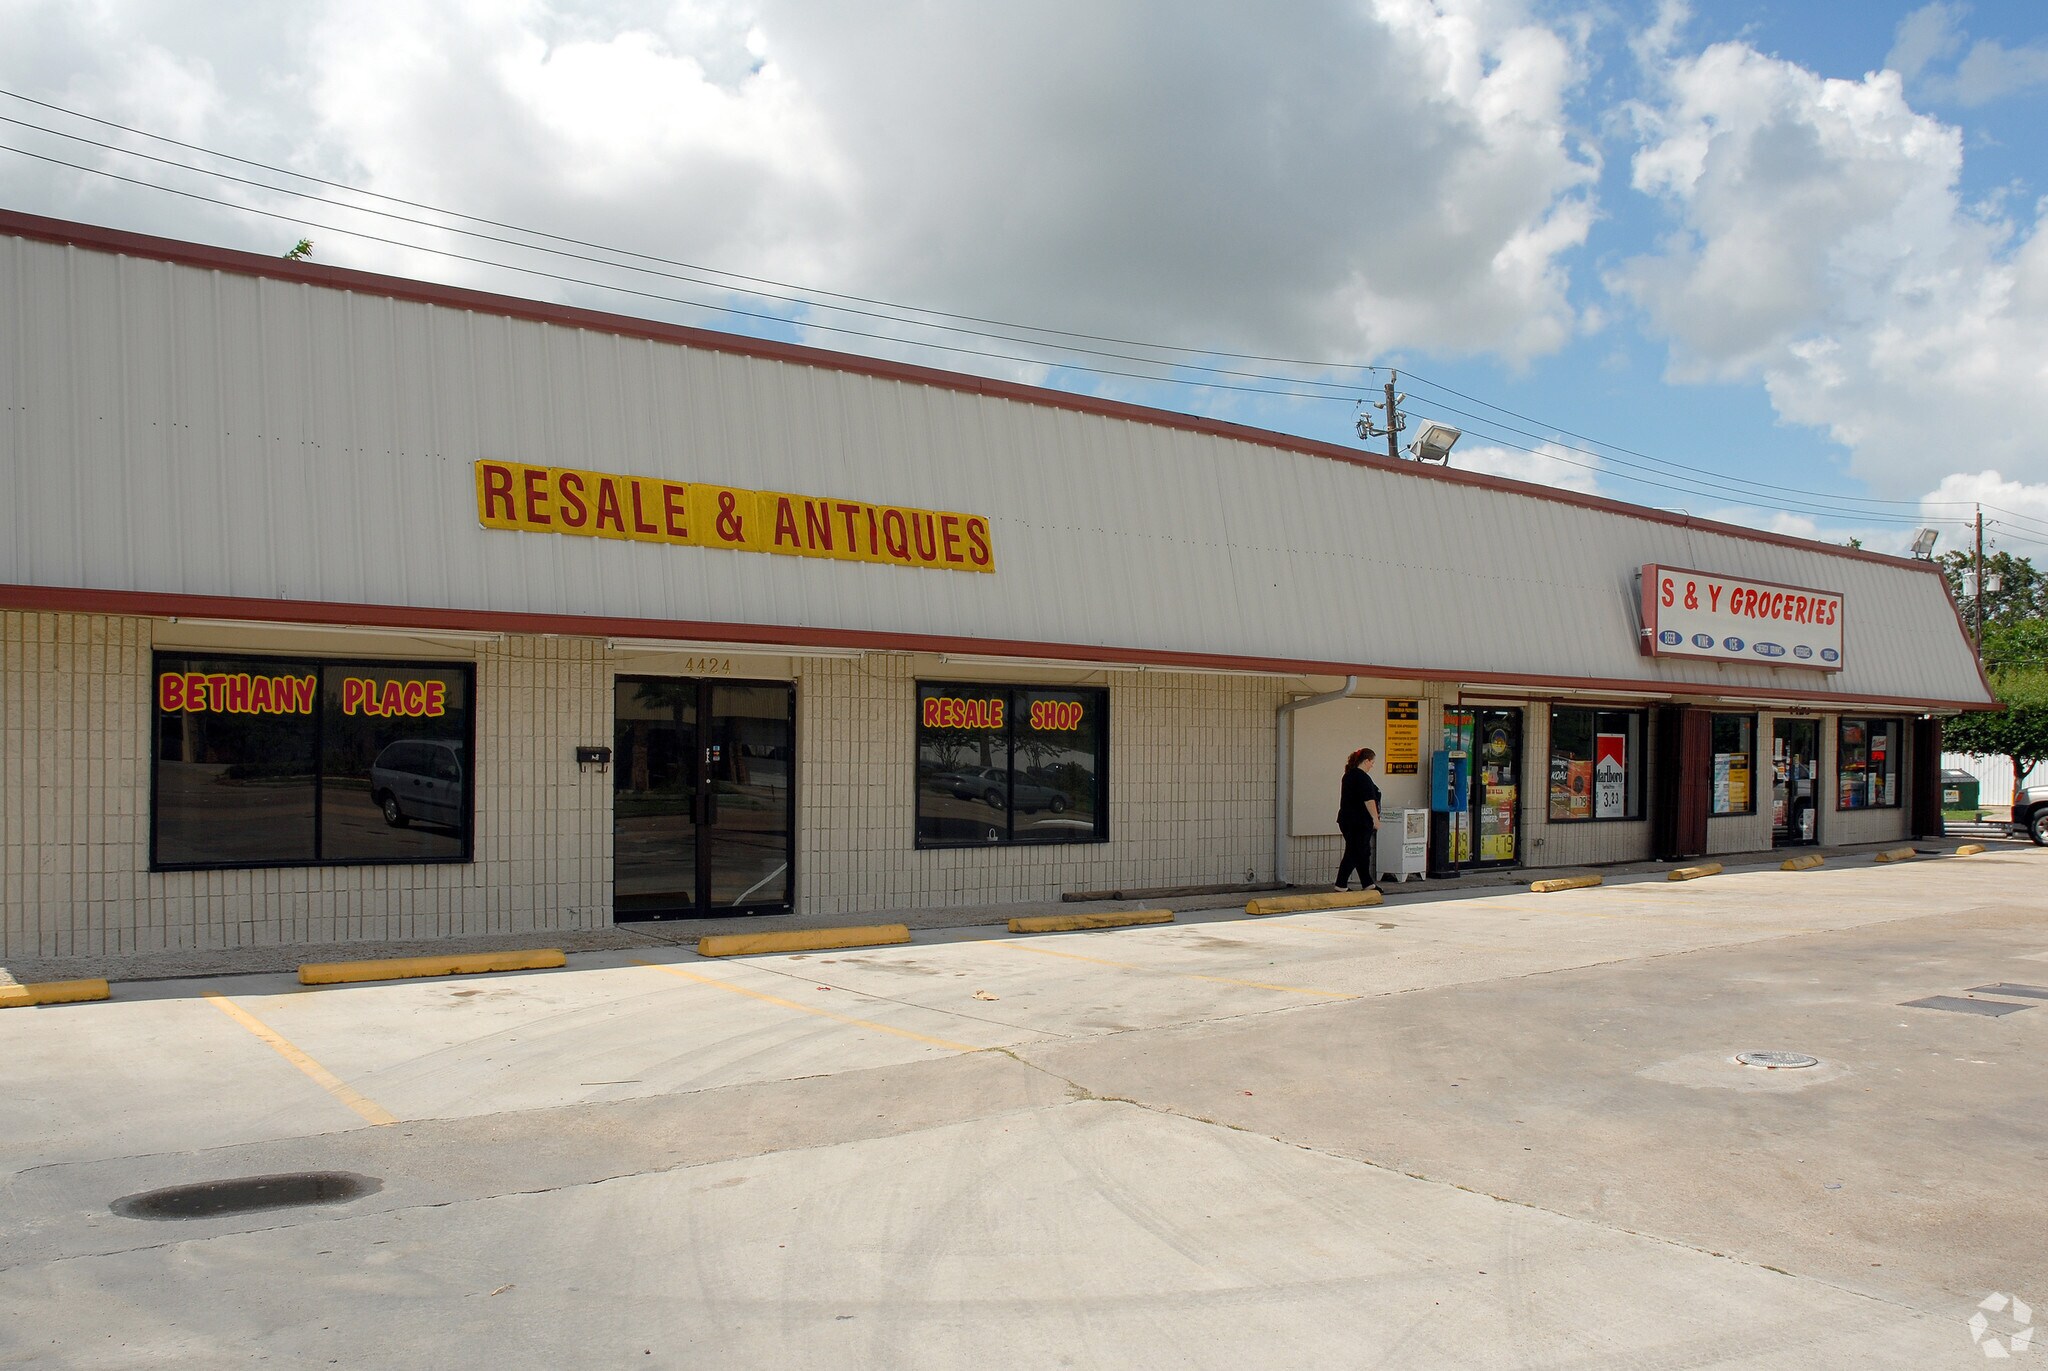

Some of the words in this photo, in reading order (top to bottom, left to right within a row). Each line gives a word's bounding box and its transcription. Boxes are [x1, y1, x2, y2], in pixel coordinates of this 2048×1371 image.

[482, 464, 690, 538] RESALE
[715, 490, 746, 543] &
[774, 496, 991, 567] ANTIQUES
[1661, 578, 1675, 608] S
[1684, 581, 1699, 610] &
[1708, 584, 1723, 613] Y
[1729, 587, 1838, 626] GROCERIES
[1664, 631, 1676, 645] BEER
[1729, 638, 1738, 651] ICE
[685, 657, 731, 675] 4424
[159, 671, 317, 715] BETHANY
[342, 676, 446, 718] PLACE
[923, 696, 1003, 729] RESALE
[1030, 699, 1083, 732] SHOP
[1551, 770, 1568, 780] KOAL
[1603, 791, 1619, 807] 3.23
